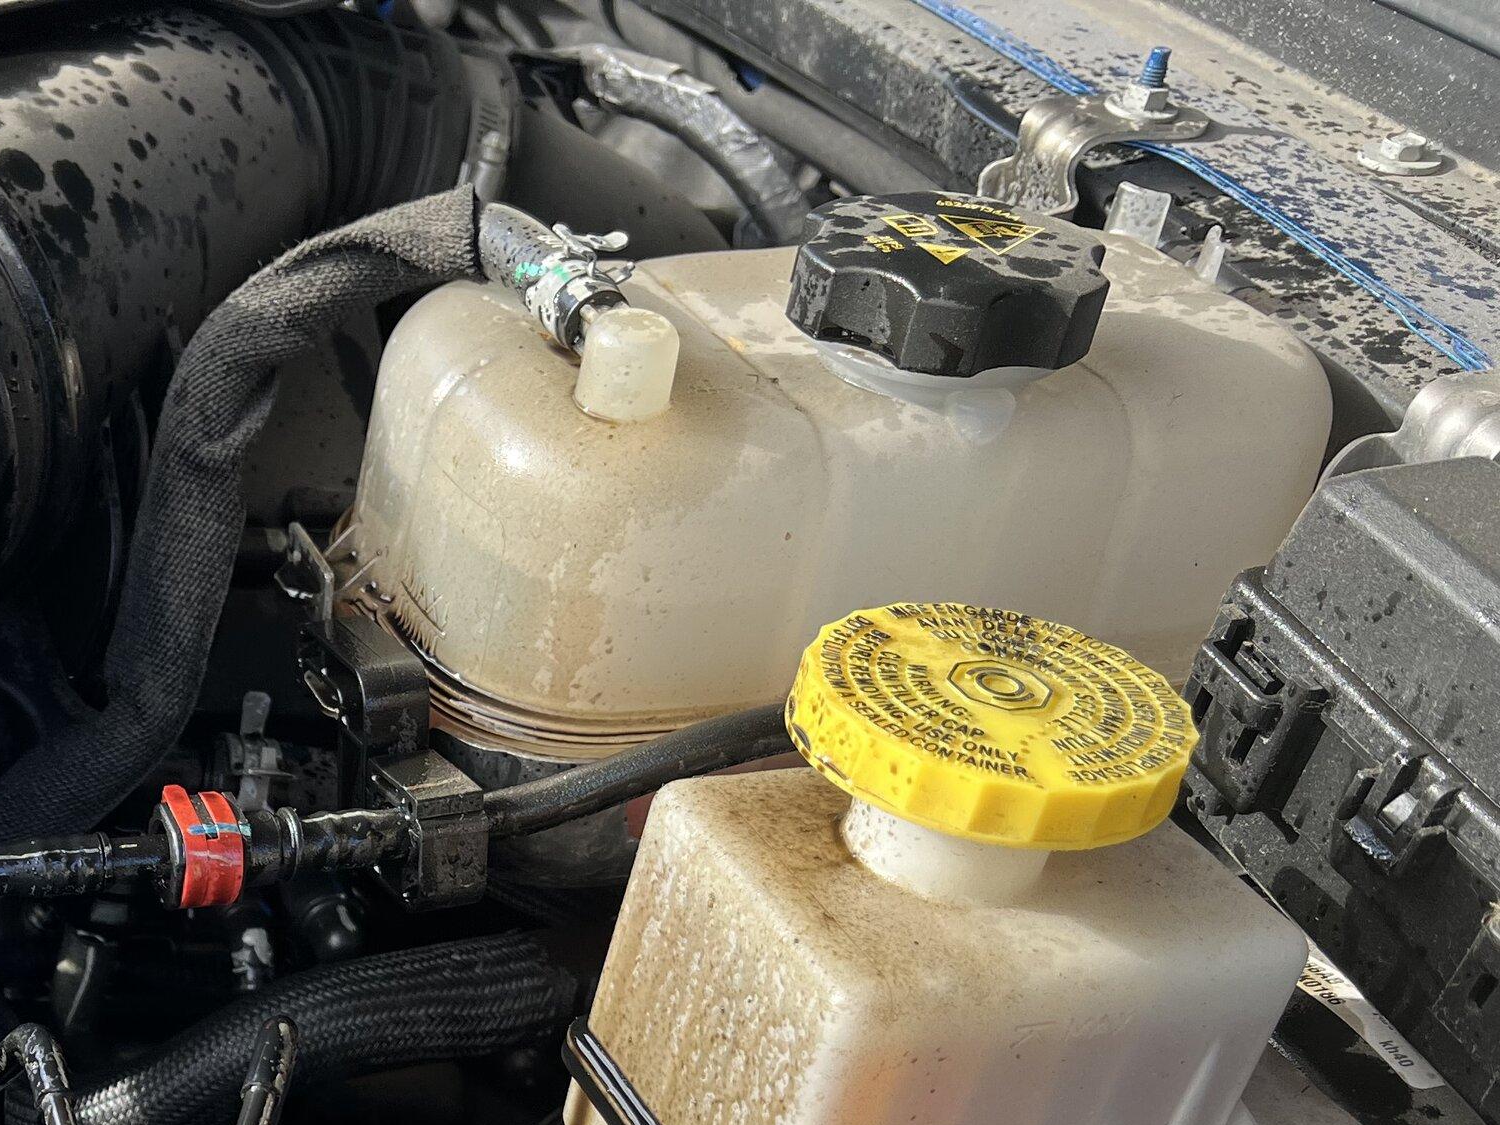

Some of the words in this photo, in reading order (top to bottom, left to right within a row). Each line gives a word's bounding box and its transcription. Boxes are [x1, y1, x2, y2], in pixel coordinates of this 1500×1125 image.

[886, 604, 930, 619] MISE
[933, 603, 960, 614] EN
[832, 629, 852, 639] 3
[841, 615, 875, 633] DOT
[982, 620, 1008, 633] DE
[1013, 626, 1039, 641] LE
[820, 634, 848, 661] FLUID
[1041, 622, 1136, 666] NETTOYER
[1042, 636, 1120, 675] RETIRER
[820, 660, 852, 690] FROM
[876, 651, 902, 681] CLEAN
[1126, 666, 1156, 680] LE
[848, 629, 892, 662] BEFORE
[912, 721, 956, 744] USE
[962, 740, 1019, 762] ONLY
[886, 684, 939, 720] FILLER
[1091, 680, 1127, 741] PROVENANT
[1113, 678, 1156, 723] UTILISER
[1143, 681, 1186, 731] BOUCHON
[849, 700, 910, 738] SEALED
[941, 718, 986, 738] CAP
[1051, 733, 1100, 751] D'UN
[1067, 722, 1155, 766] UNIQUEMENT
[1159, 730, 1186, 747] DE
[1067, 743, 1177, 781] REMPLISSAGE
